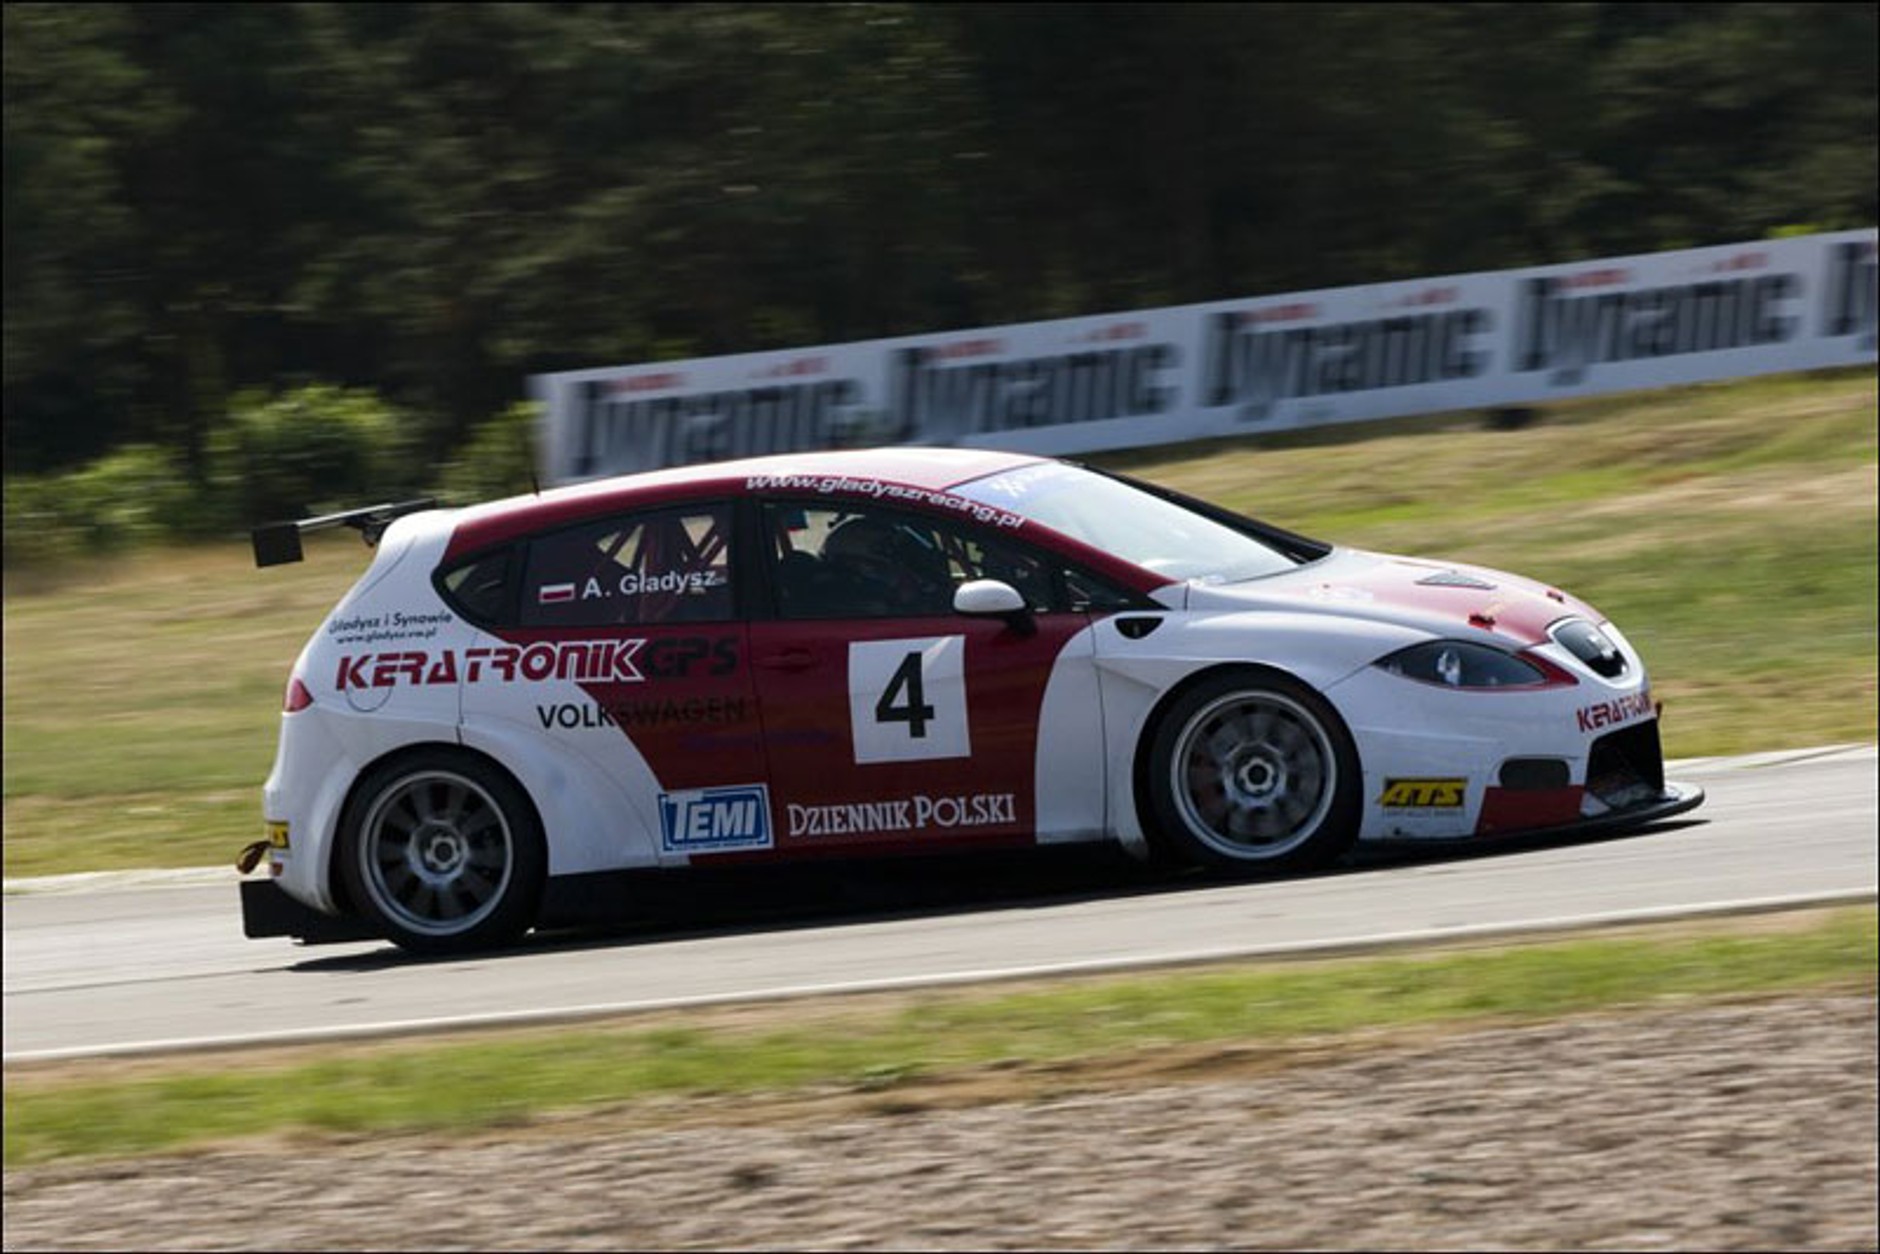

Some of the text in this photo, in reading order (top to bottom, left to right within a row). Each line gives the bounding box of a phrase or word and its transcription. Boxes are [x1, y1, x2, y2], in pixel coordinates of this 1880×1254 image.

[745, 474, 1027, 528] www.gladyszracing.pl
[582, 577, 612, 600] A.
[391, 608, 453, 628] Synowie
[536, 698, 746, 730] VOLKSWAGEN
[875, 651, 935, 739] 4
[1380, 780, 1467, 806] ATS
[667, 790, 757, 841] TEMI
[787, 793, 1017, 837] DZIENNIK POLSKI
